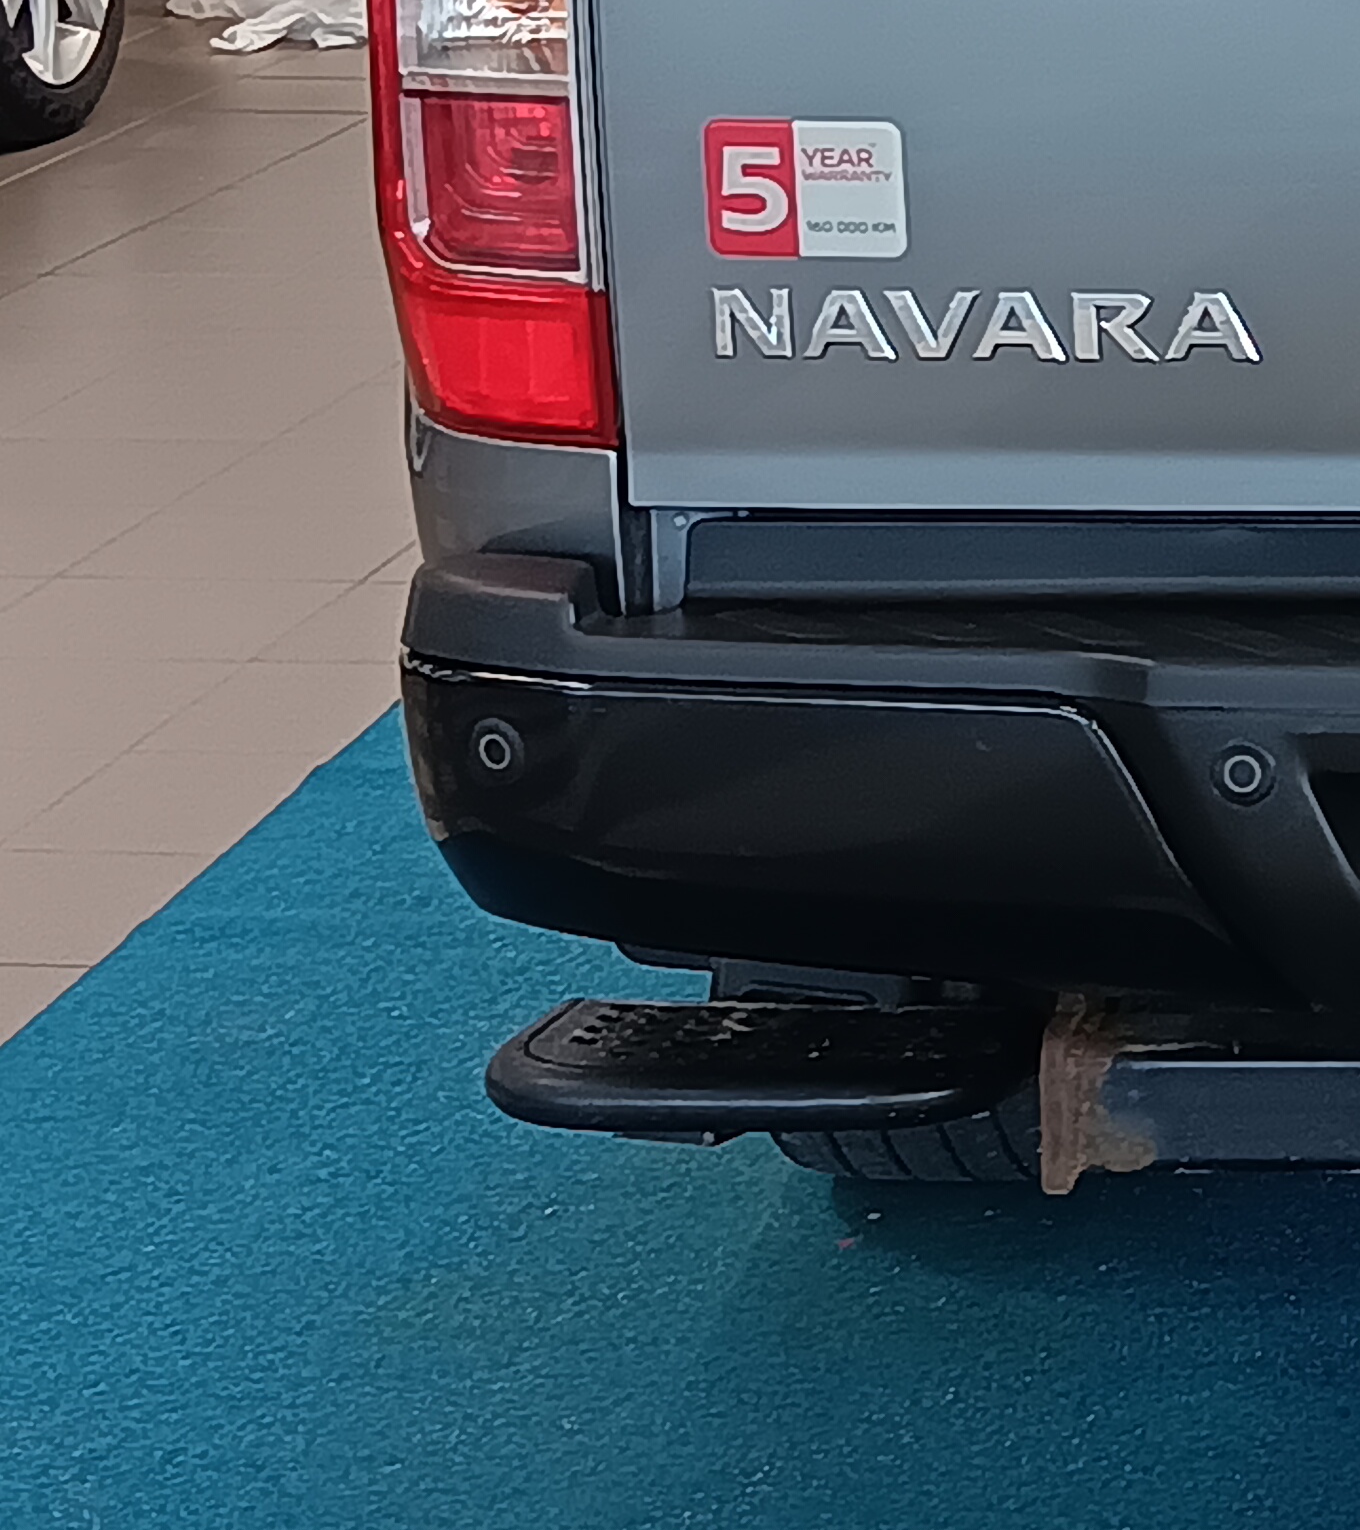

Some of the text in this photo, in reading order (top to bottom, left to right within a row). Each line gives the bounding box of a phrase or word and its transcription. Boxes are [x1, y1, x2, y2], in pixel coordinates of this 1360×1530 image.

[720, 145, 790, 234] 5
[800, 147, 874, 168] YEAR
[711, 286, 1264, 363] NAVARA
